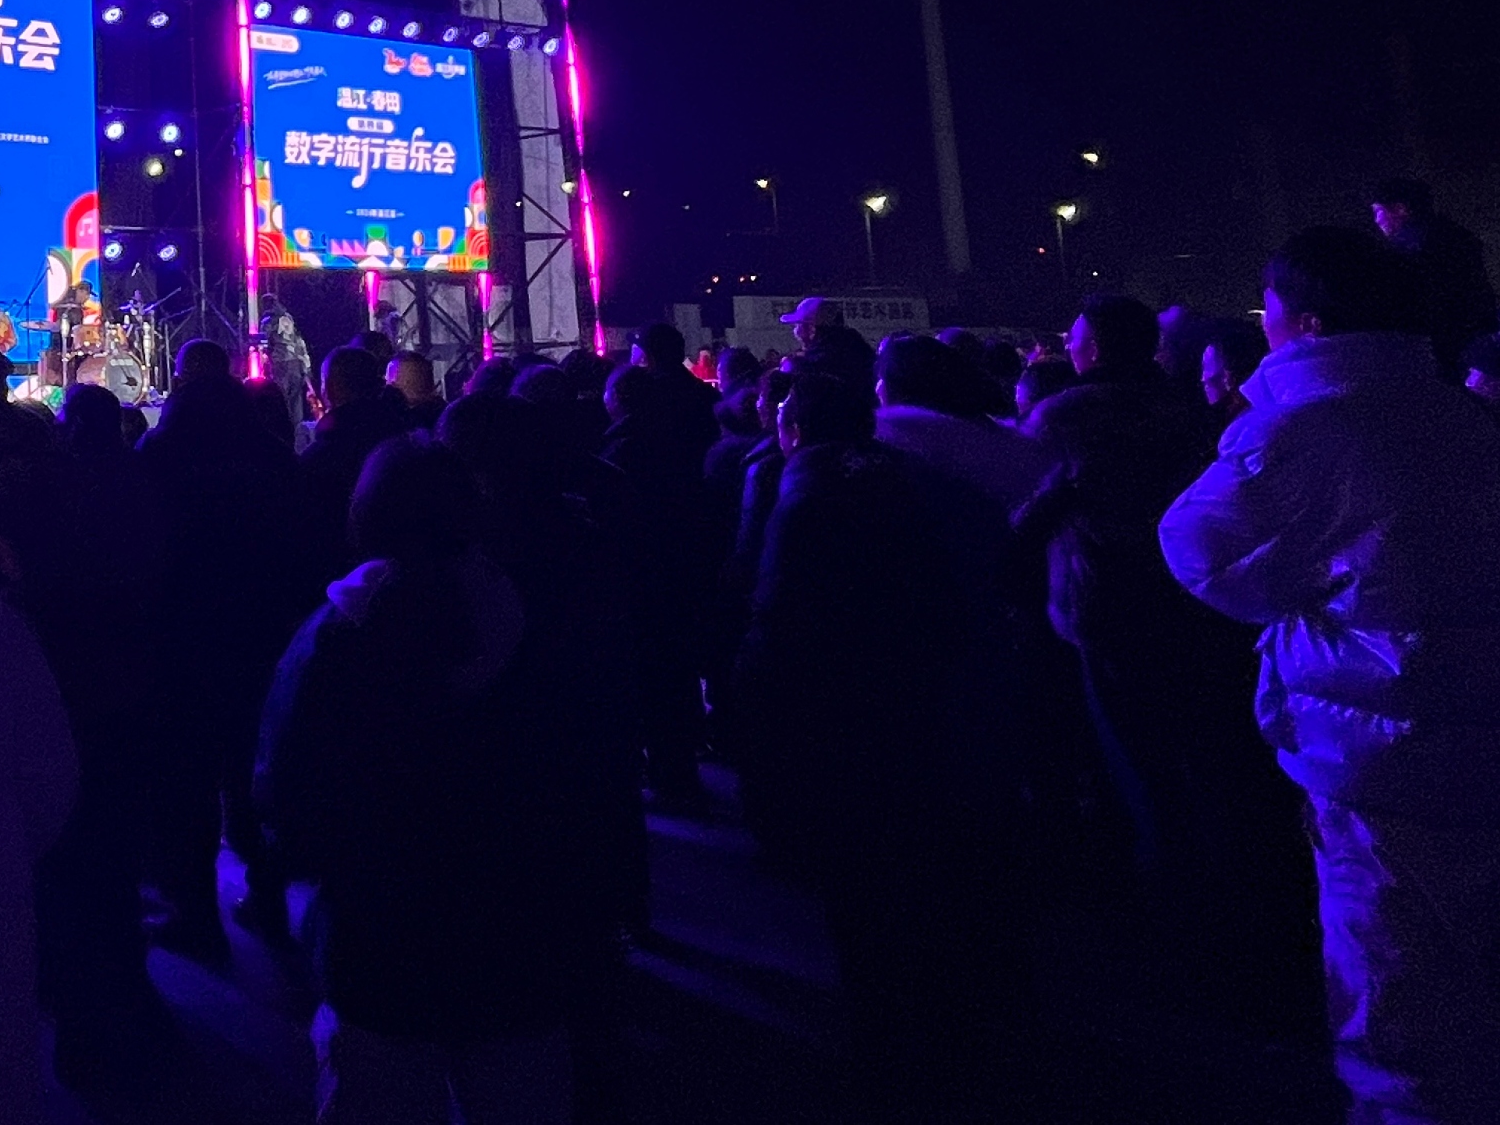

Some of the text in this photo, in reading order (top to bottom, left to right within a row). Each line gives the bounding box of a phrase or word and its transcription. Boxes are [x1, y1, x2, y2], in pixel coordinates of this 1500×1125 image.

[284, 127, 457, 189] 数字流行音乐会
